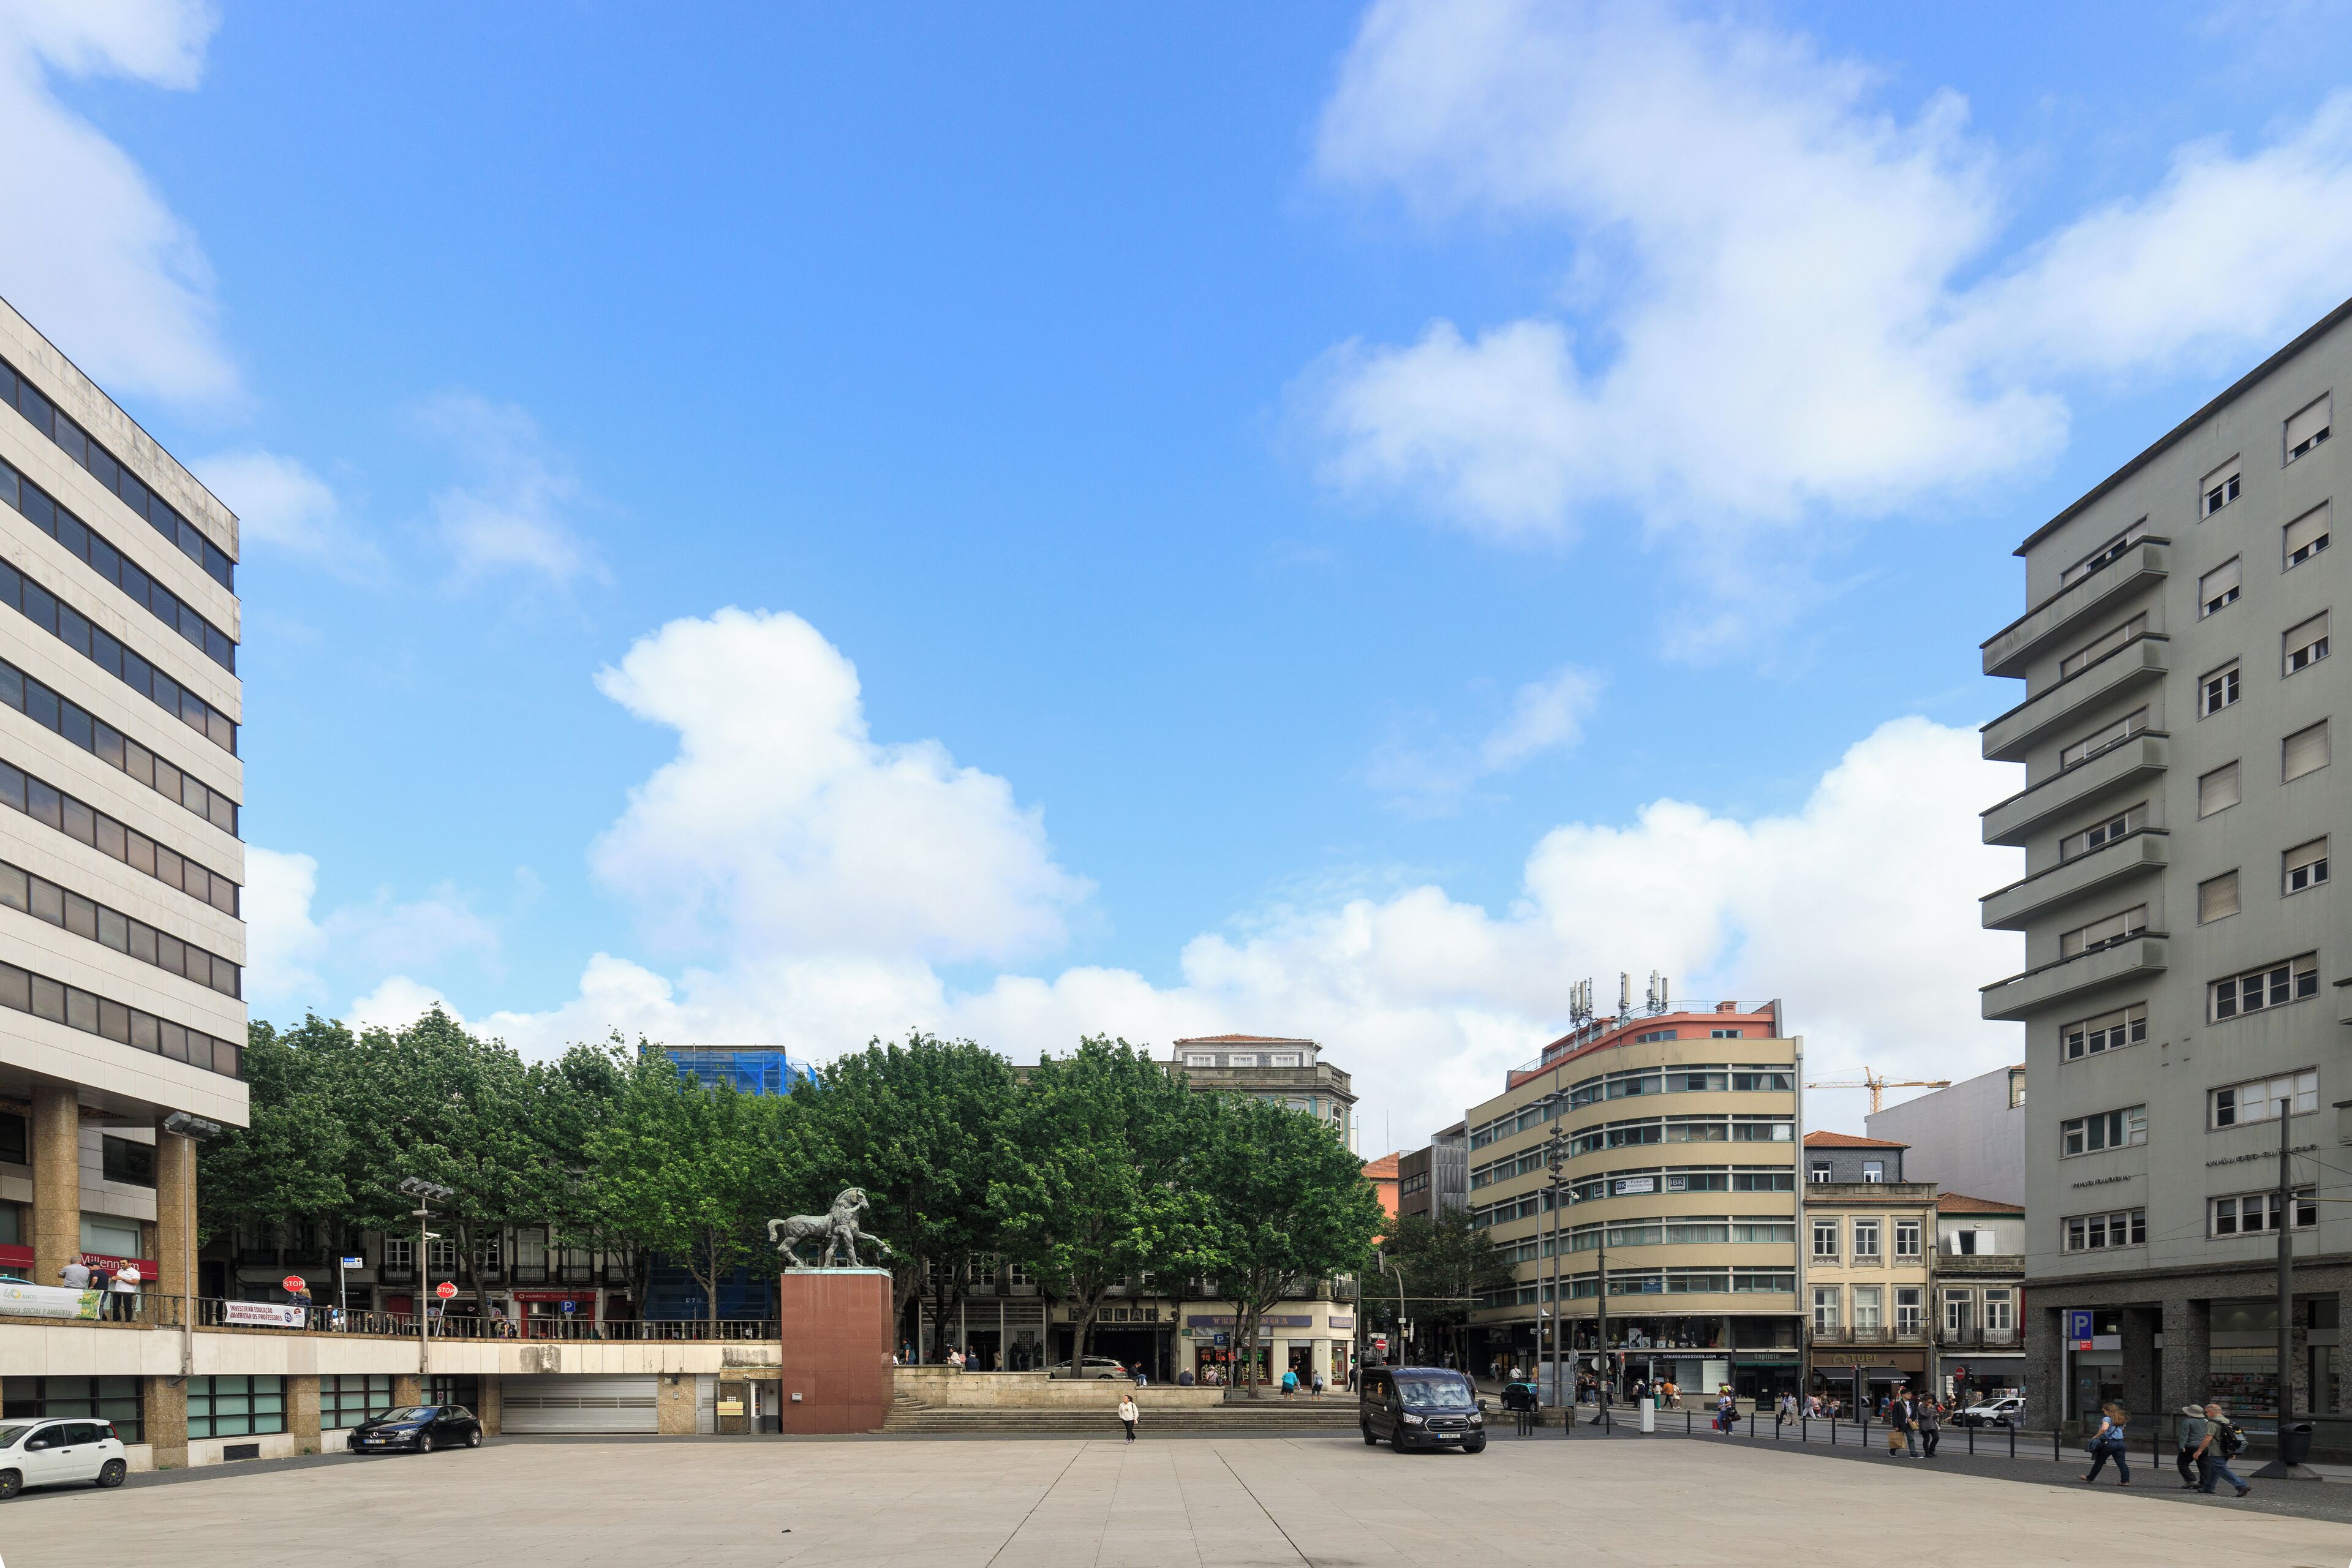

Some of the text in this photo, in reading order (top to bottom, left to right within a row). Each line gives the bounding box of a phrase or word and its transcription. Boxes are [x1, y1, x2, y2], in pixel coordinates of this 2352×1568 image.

[2262, 1144, 2316, 1157] CLÍICAS
[2071, 1175, 2130, 1188] IMAGIOLOGIA
[80, 1253, 139, 1271] Millennm
[564, 1302, 572, 1311] P
[2075, 1316, 2089, 1335] P
